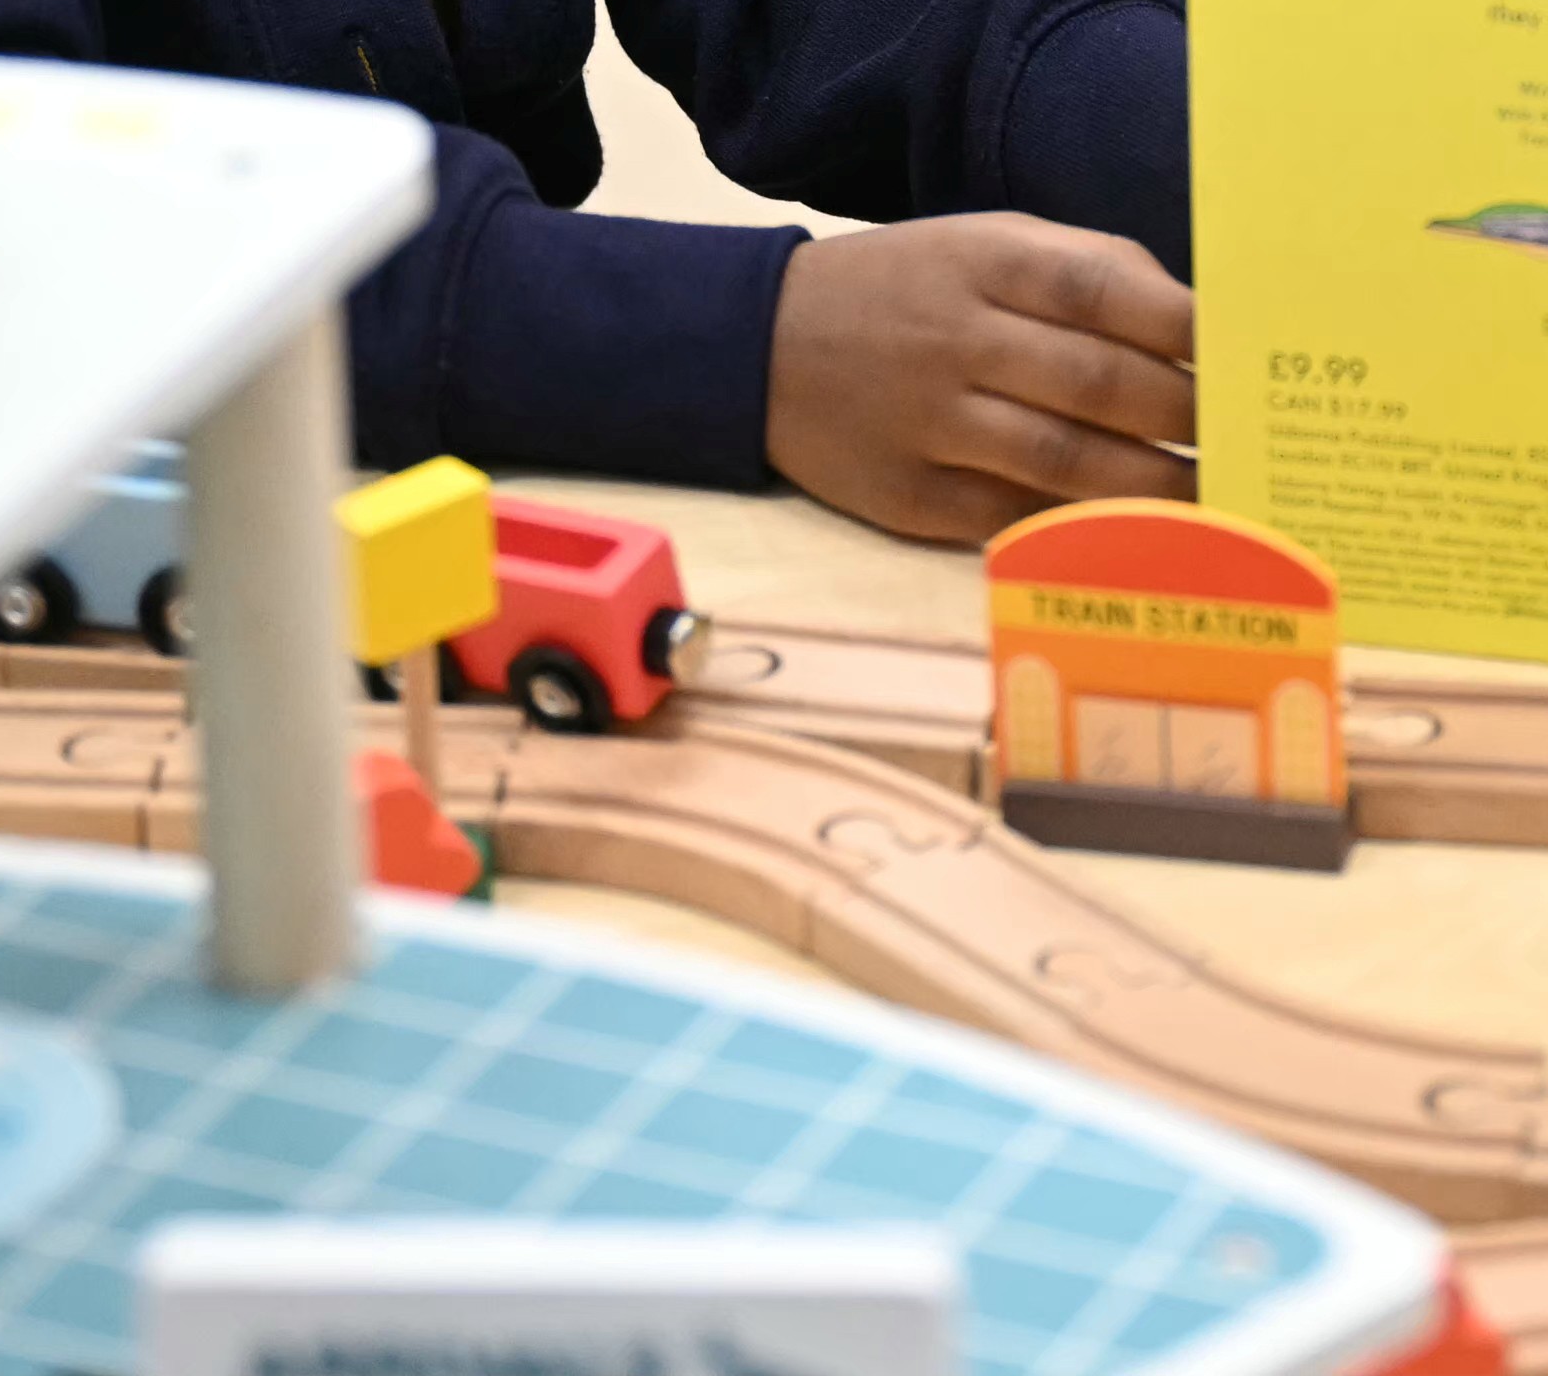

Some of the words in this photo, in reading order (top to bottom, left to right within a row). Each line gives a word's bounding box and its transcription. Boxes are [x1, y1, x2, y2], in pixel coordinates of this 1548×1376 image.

[1269, 349, 1370, 389] £9.99
[1029, 591, 1137, 632] TRAIN
[1146, 600, 1300, 646] STATION
